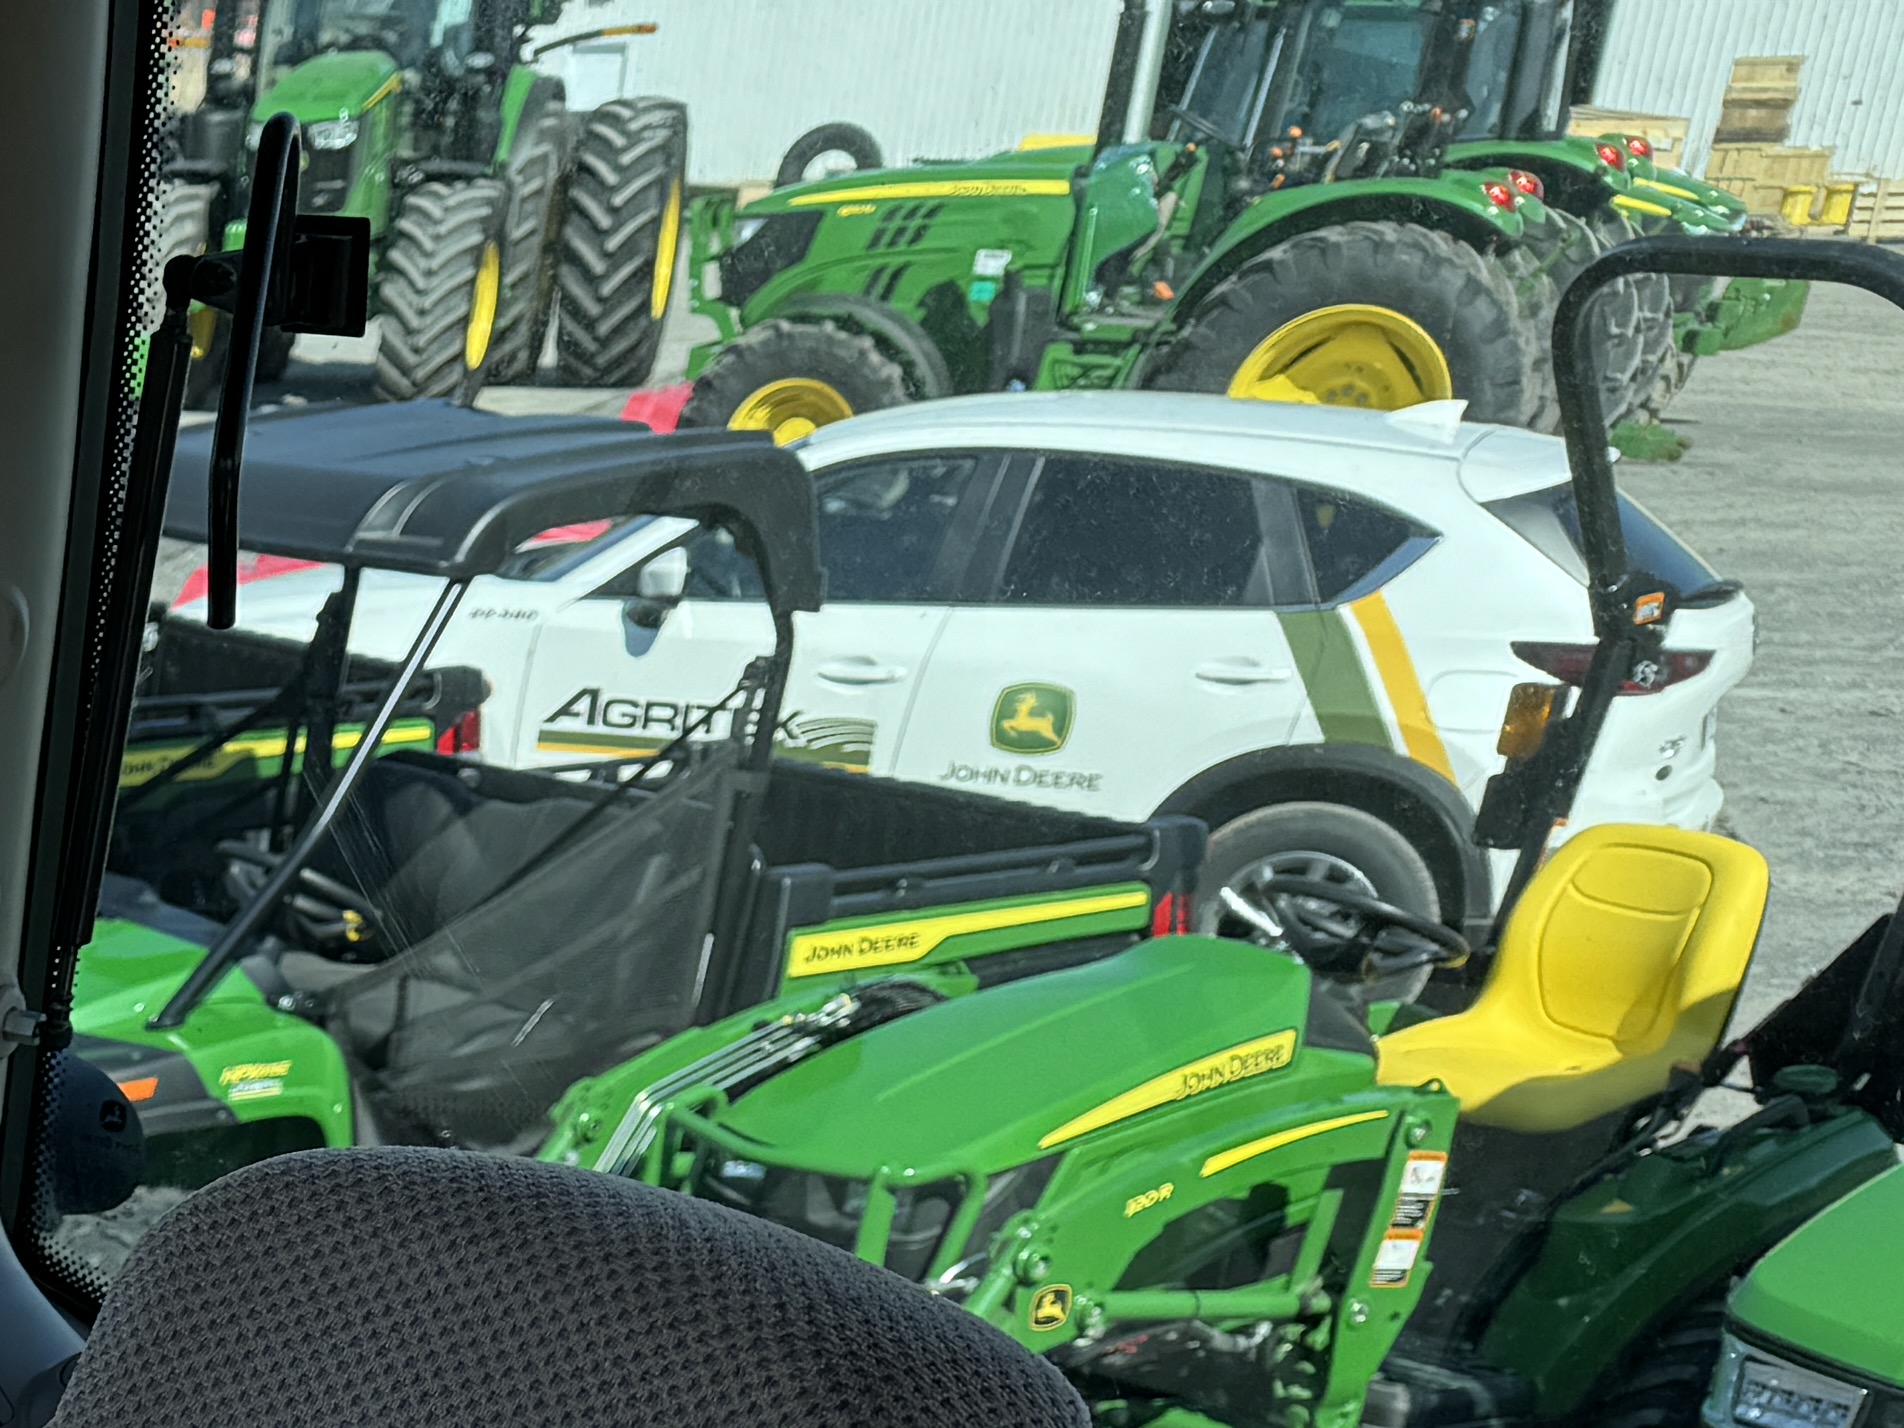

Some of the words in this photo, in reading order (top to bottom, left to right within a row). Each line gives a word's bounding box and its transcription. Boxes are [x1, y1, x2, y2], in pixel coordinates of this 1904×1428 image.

[543, 687, 803, 739] AGRITK
[940, 760, 1012, 785] JOHN
[1013, 764, 1104, 792] DEERE
[803, 942, 854, 963] JOHN
[857, 932, 921, 957] DEERE
[1176, 1063, 1226, 1097] JOHN
[1228, 1045, 1285, 1076] DEERE
